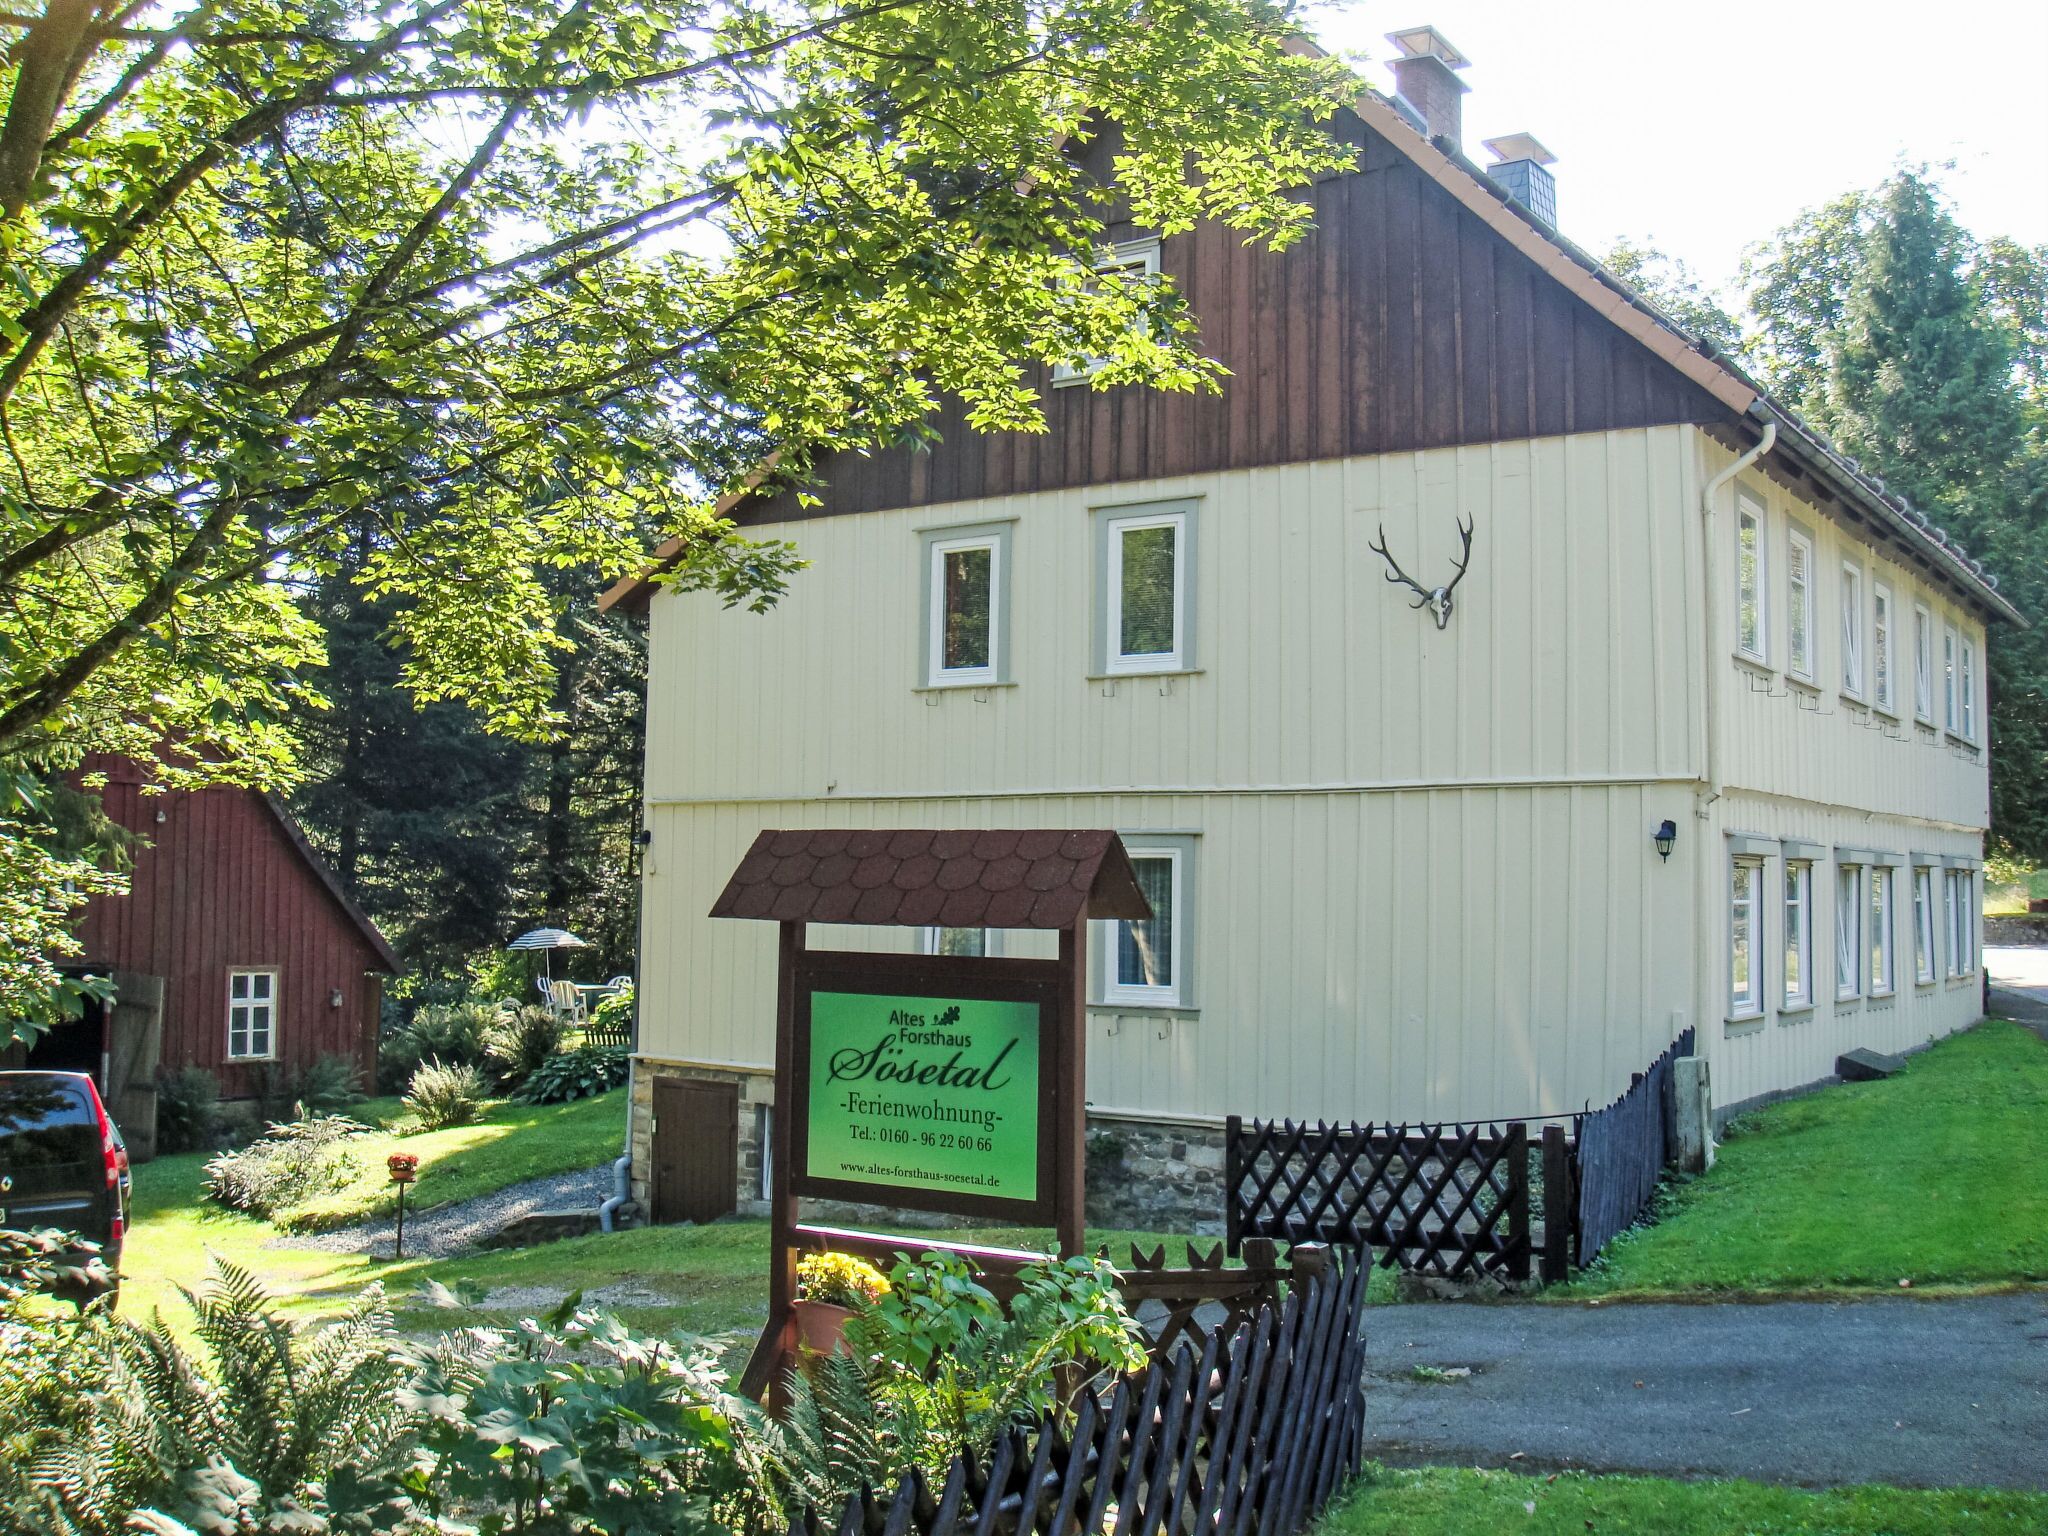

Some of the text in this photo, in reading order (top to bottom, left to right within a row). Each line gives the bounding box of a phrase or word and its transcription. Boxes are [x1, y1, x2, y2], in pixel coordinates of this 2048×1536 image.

[889, 1009, 925, 1027] Altes
[899, 1027, 972, 1048] Forsthaus
[826, 1033, 1019, 1091] Sösetal
[840, 1091, 1003, 1132] -Ferienwohnung-
[849, 1124, 876, 1142] Tel.:
[879, 1127, 909, 1145] 0160
[921, 1131, 936, 1147] 96
[939, 1133, 955, 1149] 22
[957, 1135, 974, 1151] 60
[976, 1137, 993, 1152] 66
[840, 1161, 1000, 1188] www.altes-forsthaus-soesetal.de
